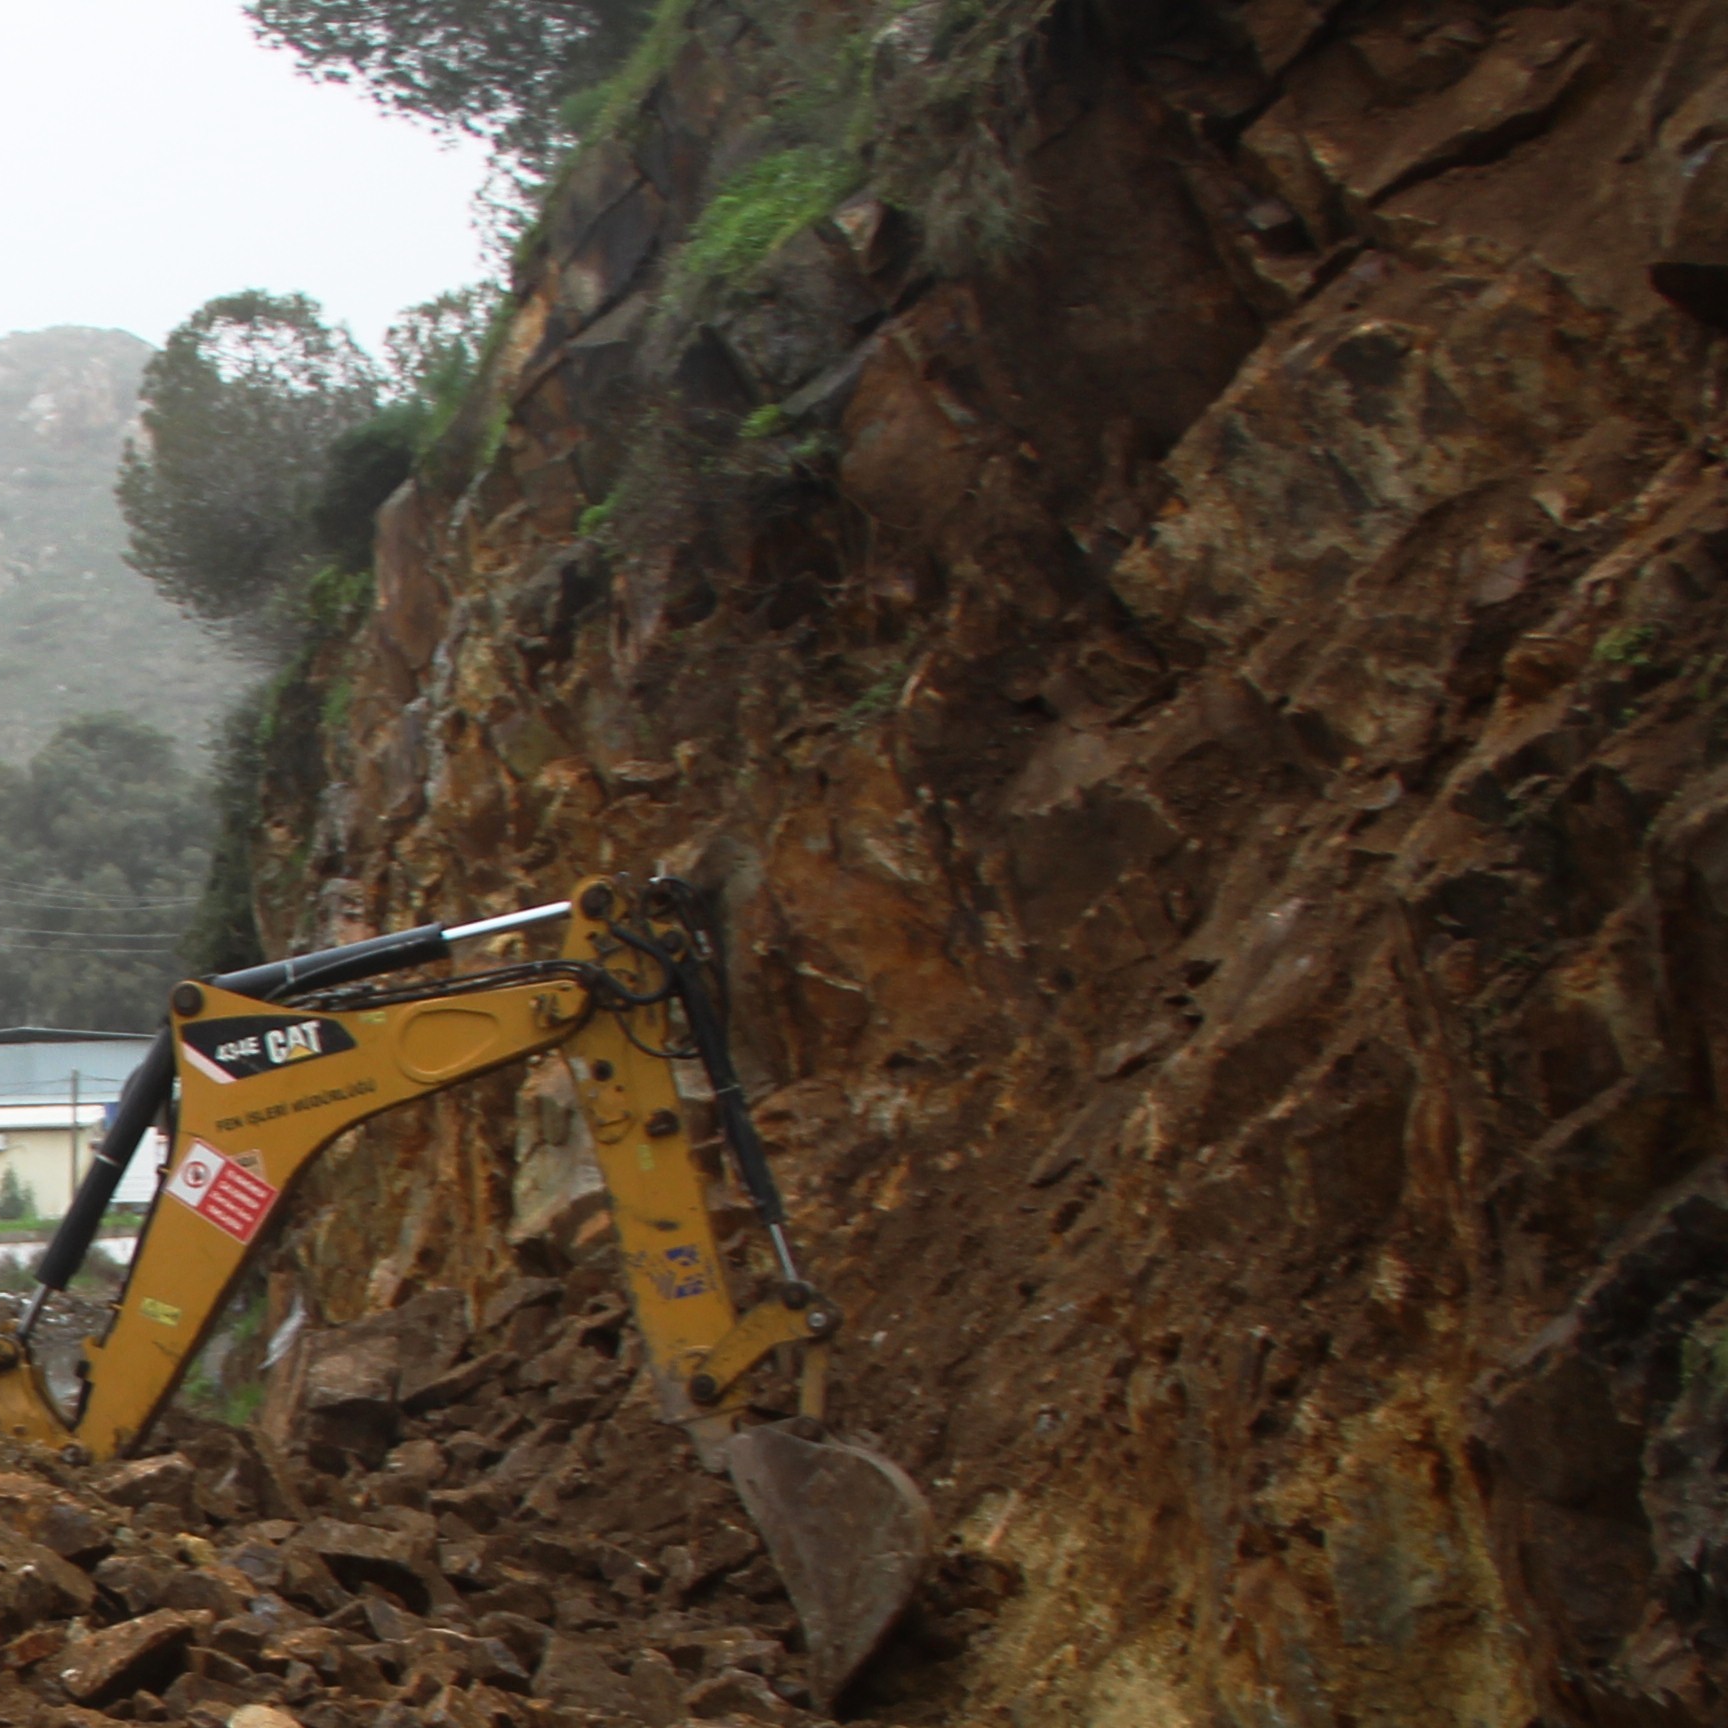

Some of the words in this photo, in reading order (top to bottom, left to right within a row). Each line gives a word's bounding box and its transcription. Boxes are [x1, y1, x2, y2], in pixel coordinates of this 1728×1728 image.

[215, 1036, 260, 1062] 434E
[264, 1019, 322, 1064] CAT
[215, 1115, 243, 1132] FEN
